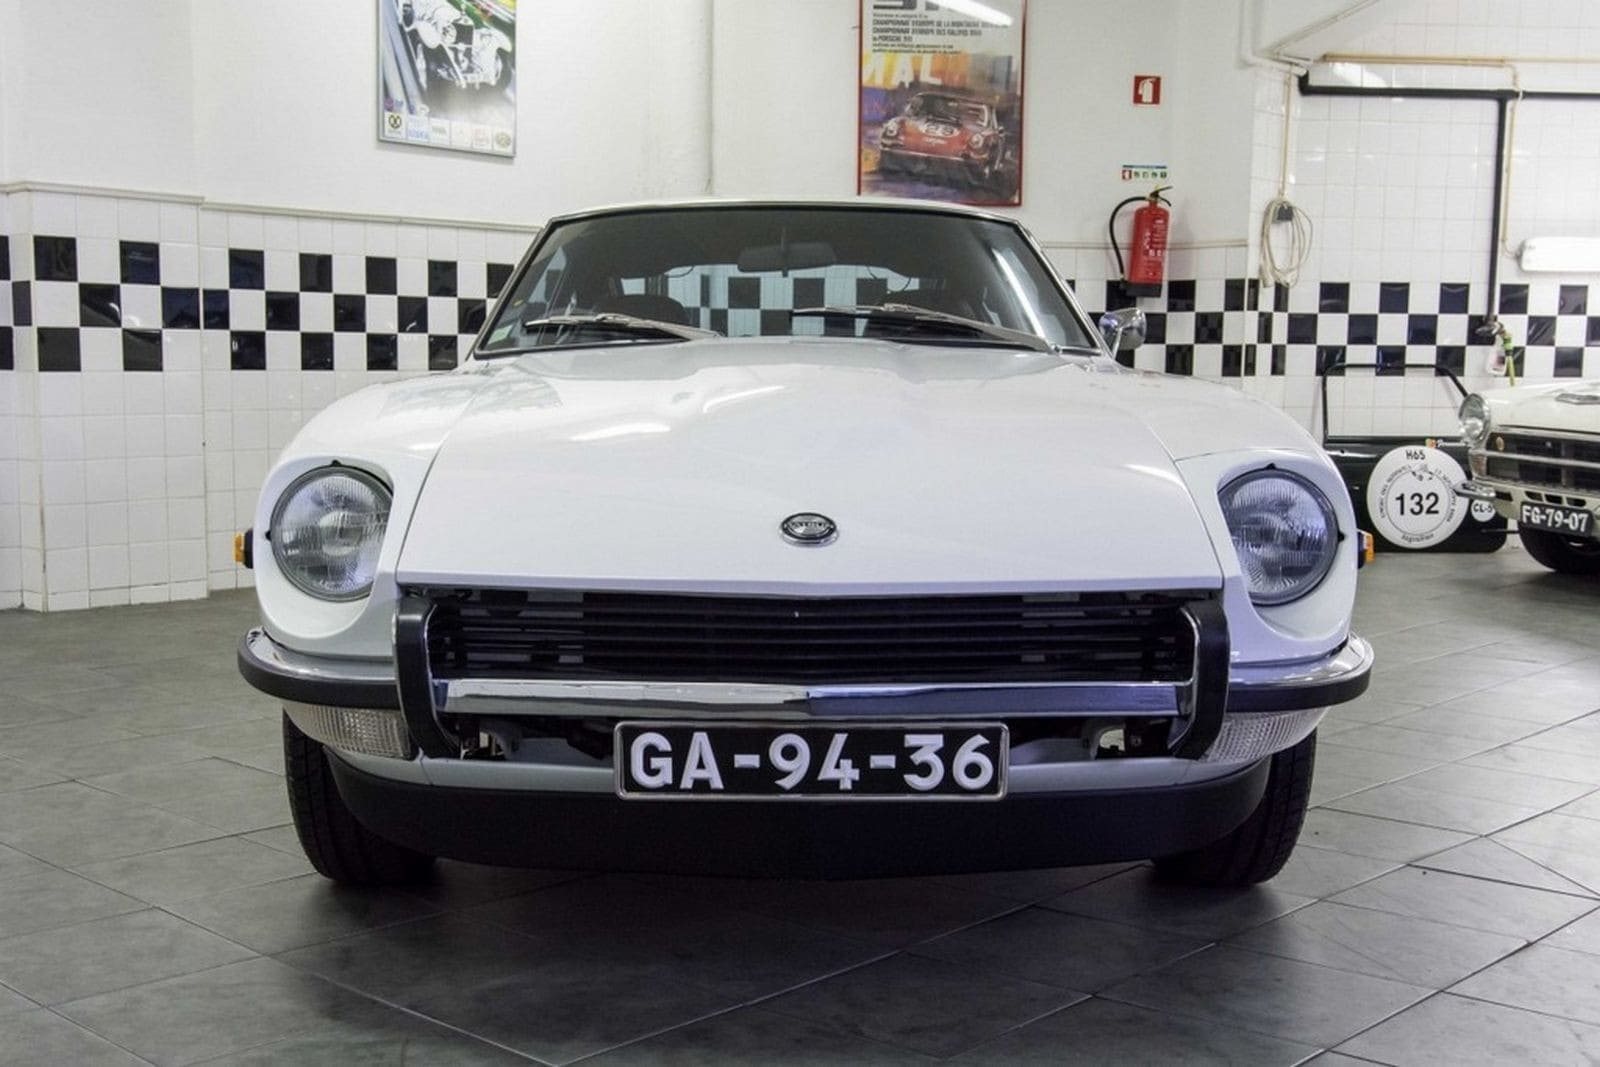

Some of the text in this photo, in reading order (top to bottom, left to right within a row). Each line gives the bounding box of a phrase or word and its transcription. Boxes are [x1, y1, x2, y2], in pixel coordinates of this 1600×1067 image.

[1395, 492, 1440, 516] 132
[1521, 505, 1589, 532] FG-79-07
[630, 731, 994, 791] GA-94-36
